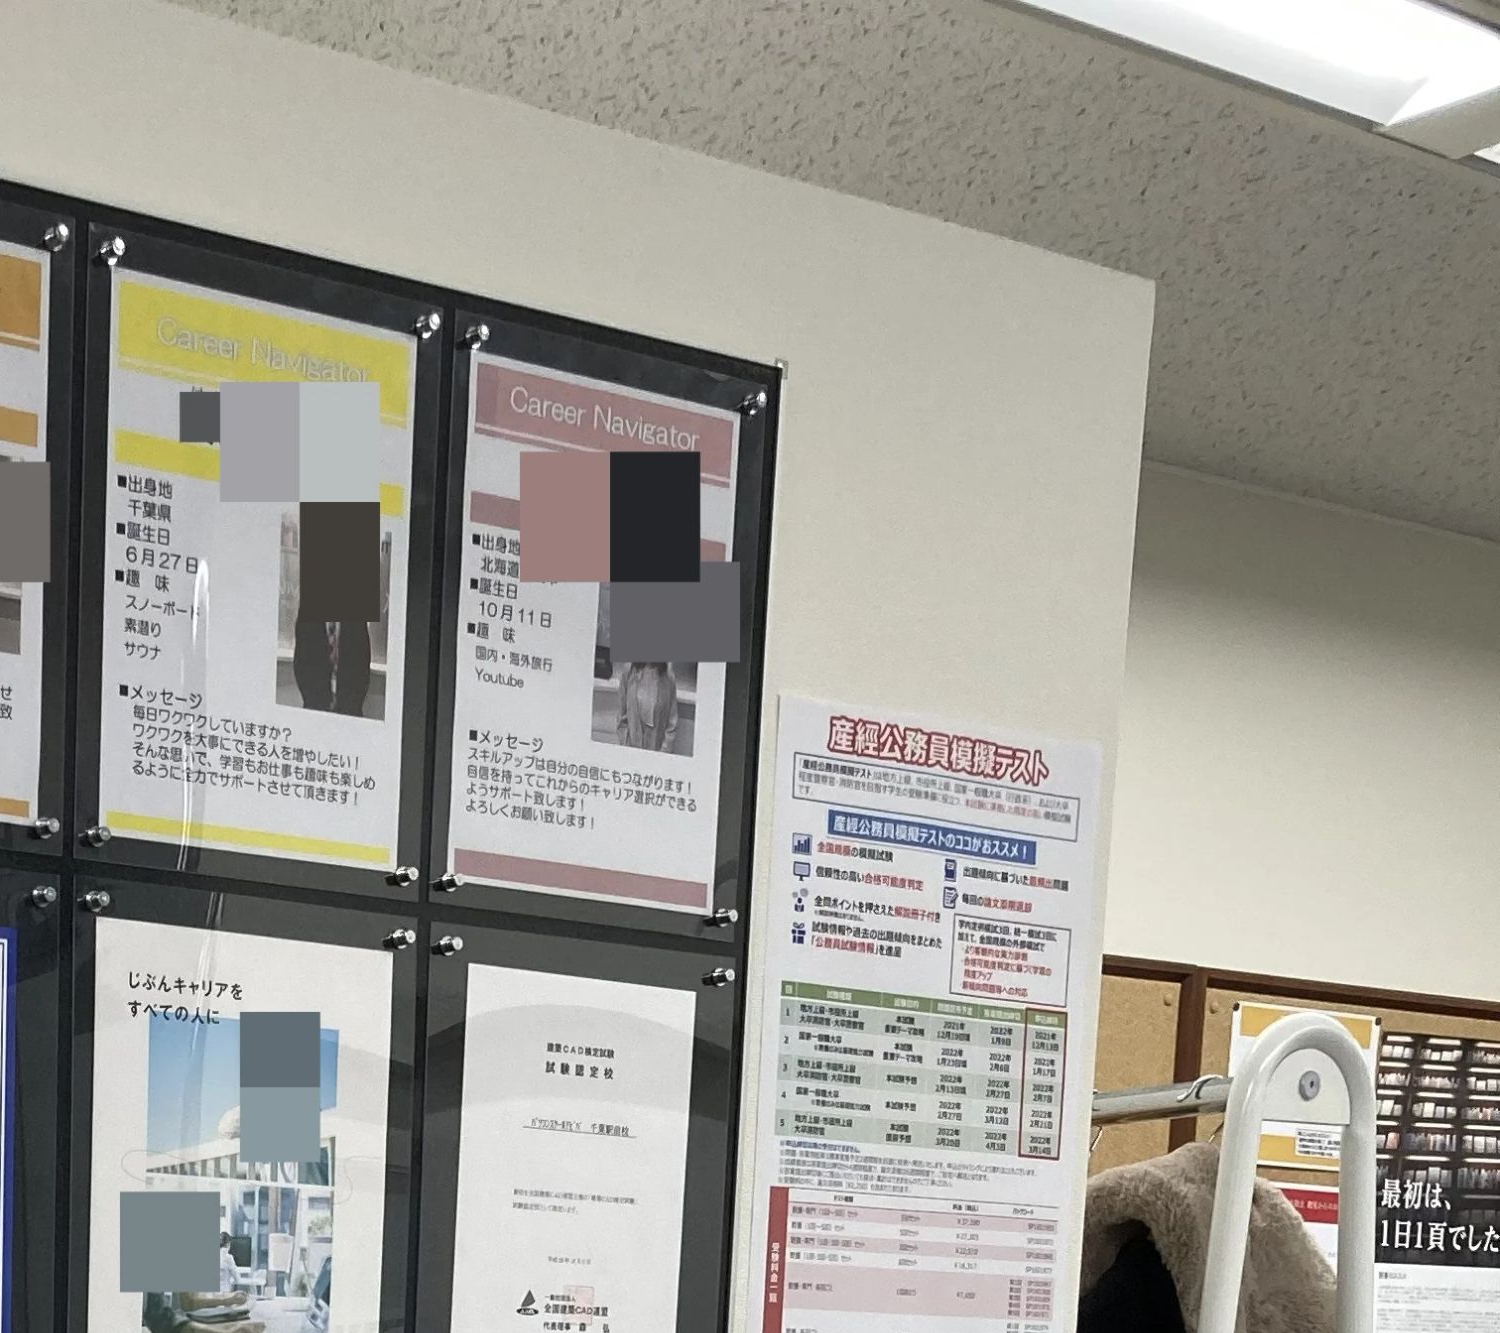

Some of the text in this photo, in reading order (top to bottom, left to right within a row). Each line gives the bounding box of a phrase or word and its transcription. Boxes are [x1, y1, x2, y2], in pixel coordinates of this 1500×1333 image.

[157, 317, 370, 382] Career Navigator
[510, 386, 700, 451] Career Navigator
[128, 475, 173, 499] 出身地
[128, 500, 172, 523] 千葉県
[127, 521, 170, 546] 誕生日
[480, 557, 519, 578] 北海道
[479, 578, 518, 599] 誕生日
[479, 601, 551, 627] 10月11日
[124, 619, 162, 638] 素潜り
[124, 642, 162, 660] サウナ
[475, 668, 525, 689] Youtube
[131, 685, 202, 709] メッセージ
[479, 730, 543, 753] メッセージ
[128, 971, 243, 1000] じぶんキャリアを
[128, 1000, 220, 1024] すべての人に
[1381, 1178, 1451, 1210] 最初は、
